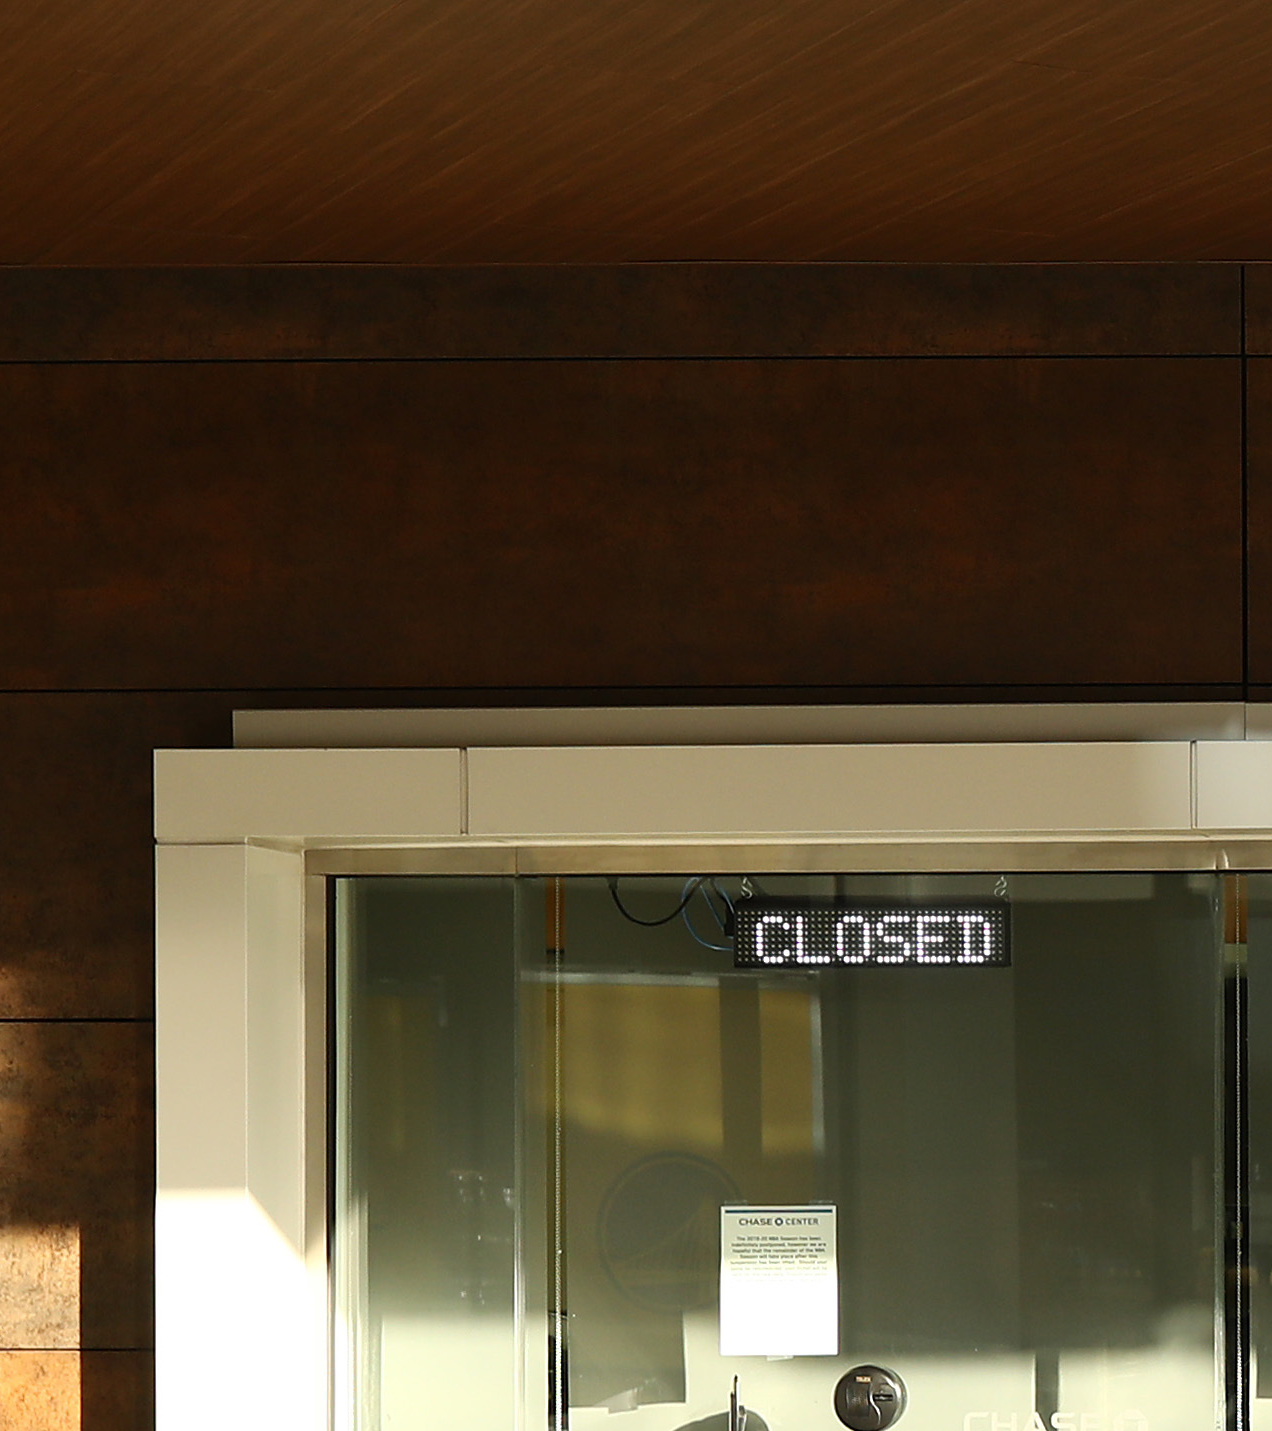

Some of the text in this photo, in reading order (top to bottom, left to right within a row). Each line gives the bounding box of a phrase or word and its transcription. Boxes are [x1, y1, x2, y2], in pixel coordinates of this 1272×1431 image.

[756, 915, 991, 964] CLOSED
[738, 1218, 819, 1226] CHASE CENTER
